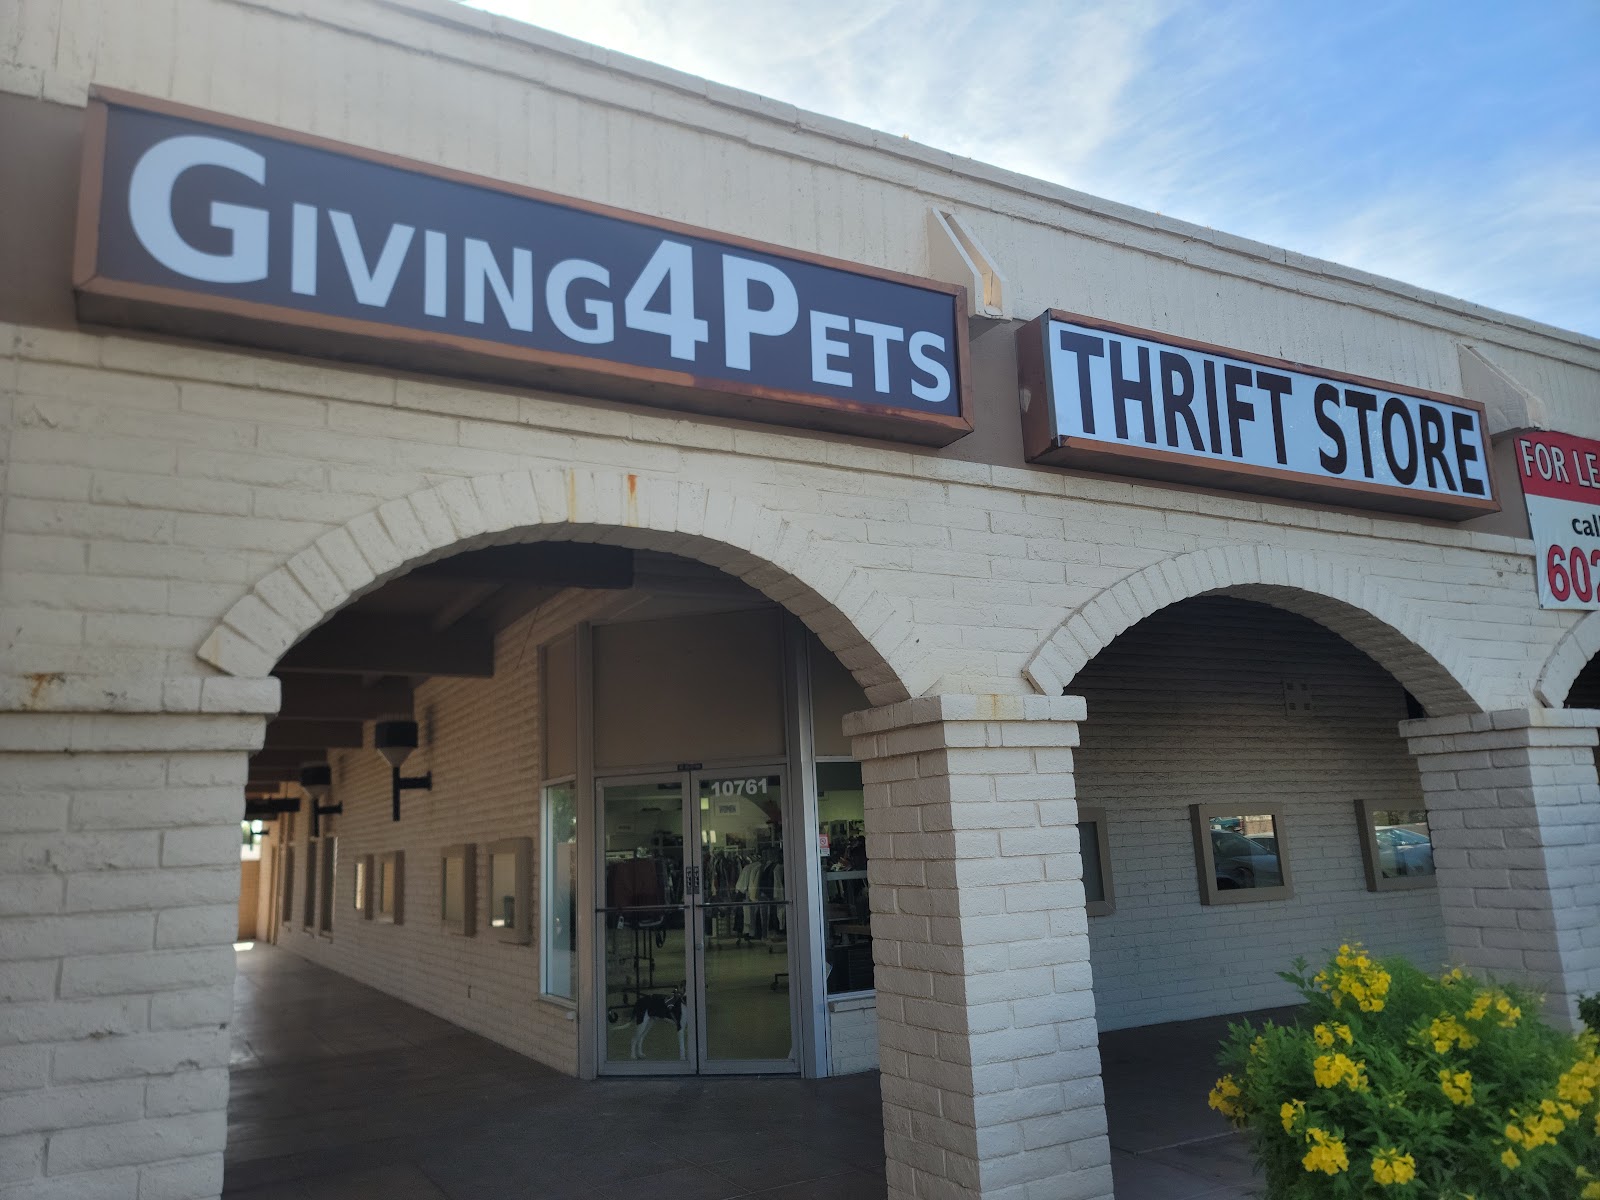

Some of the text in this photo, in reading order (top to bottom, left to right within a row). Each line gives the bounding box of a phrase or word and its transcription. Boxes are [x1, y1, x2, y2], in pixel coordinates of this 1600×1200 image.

[1060, 329, 1485, 496] THRIFT STORE
[1520, 439, 1570, 484] FOR
[1571, 513, 1600, 538] cal
[711, 778, 767, 797] 10761
